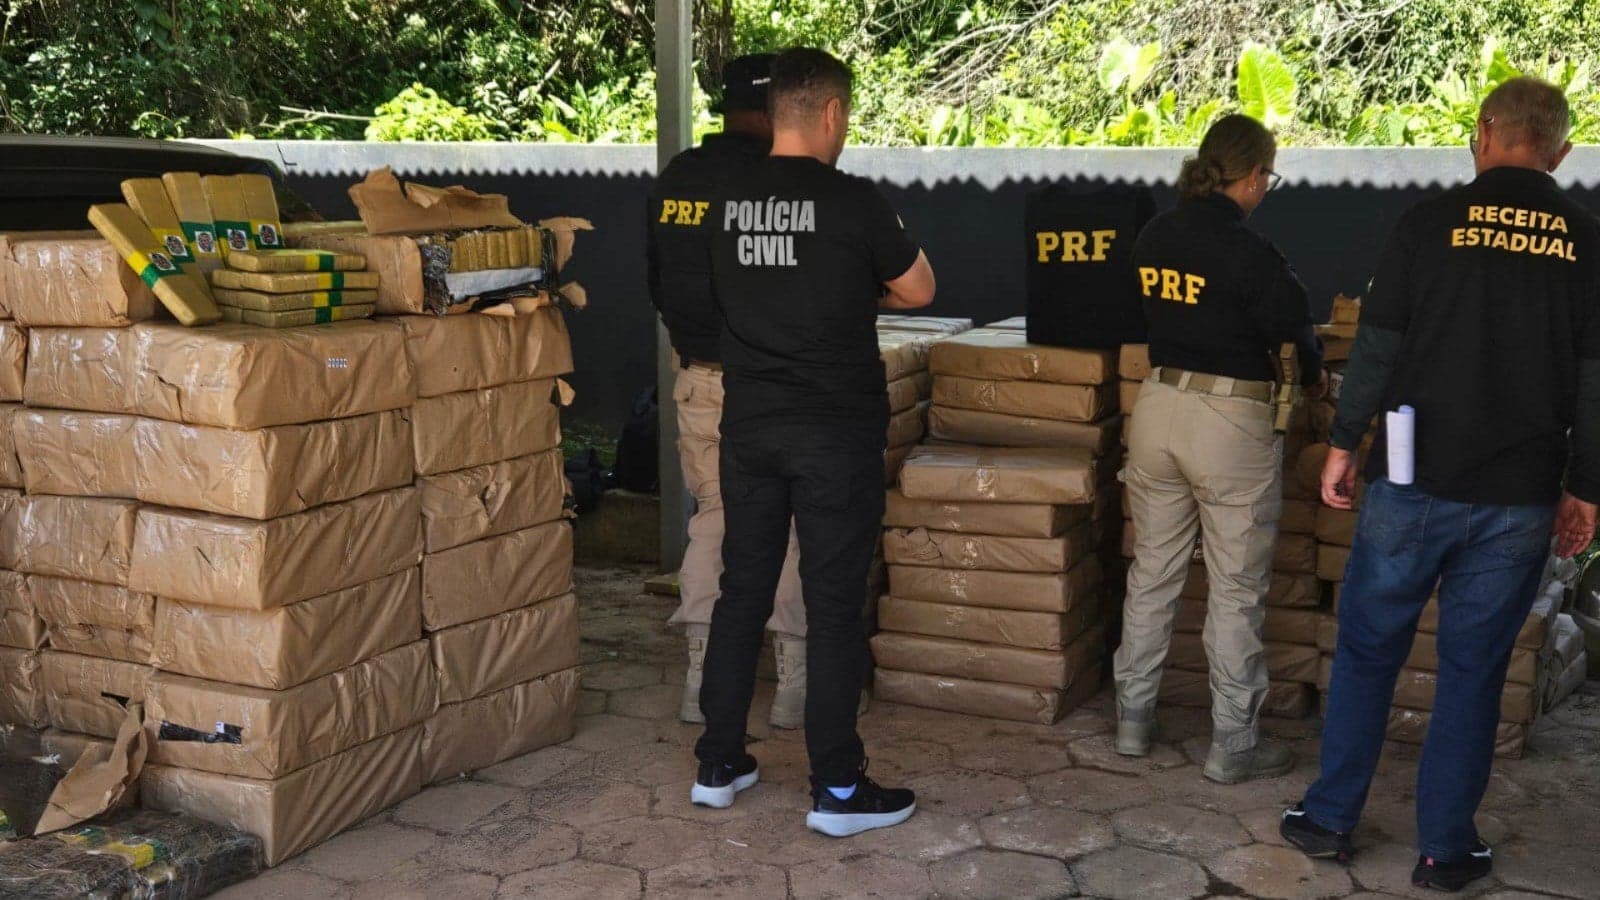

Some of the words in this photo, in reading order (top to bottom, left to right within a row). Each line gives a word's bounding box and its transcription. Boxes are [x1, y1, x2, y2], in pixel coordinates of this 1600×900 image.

[660, 200, 709, 225] PRF
[724, 196, 815, 232] POLÍCIA
[1468, 205, 1568, 233] RECEITA
[738, 235, 798, 266] CIVIL
[1037, 230, 1116, 262] PRF
[1451, 227, 1577, 262] ESTADUAL
[1139, 267, 1206, 305] PRF
